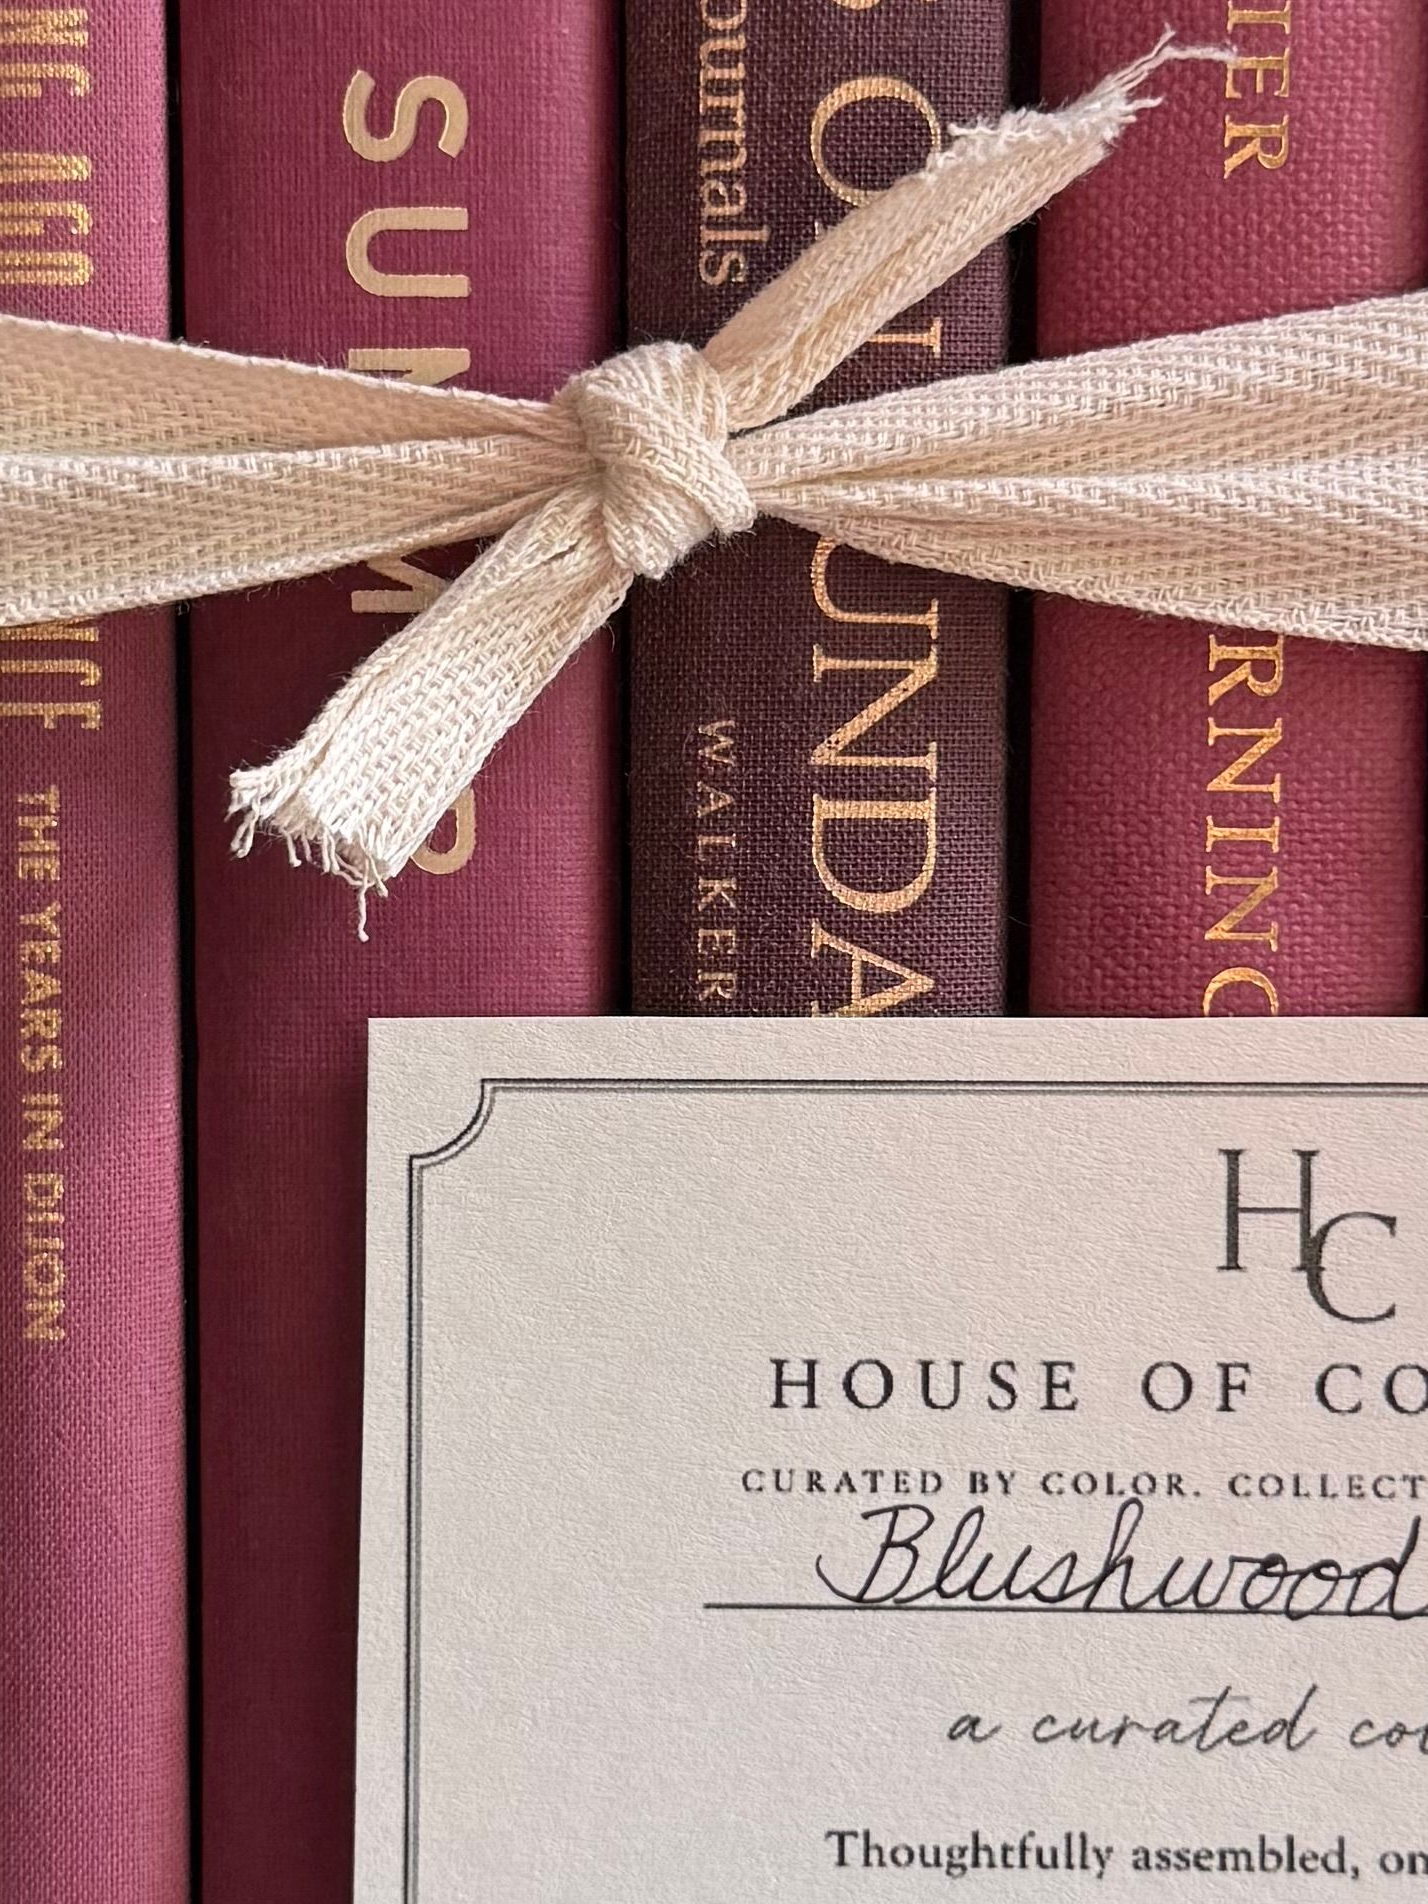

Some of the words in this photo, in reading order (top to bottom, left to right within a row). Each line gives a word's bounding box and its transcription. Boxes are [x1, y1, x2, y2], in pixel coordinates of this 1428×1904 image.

[809, 534, 940, 1018] UNDA
[16, 784, 64, 882] THE
[695, 718, 739, 1002] WALKER
[16, 901, 66, 1075] YEARS
[20, 1091, 66, 1151] IN
[20, 1172, 69, 1344] DIJON
[770, 1358, 1078, 1412] HOUSE
[1141, 1361, 1251, 1413] OF
[742, 1469, 943, 1495] CURATED
[969, 1470, 1015, 1496] BY
[1040, 1472, 1200, 1503] COLOR.
[947, 1714, 1001, 1743] a
[1032, 1684, 1318, 1754] curated
[825, 1829, 1113, 1880] Thoughtfully
[1132, 1834, 1359, 1880] assembled,
